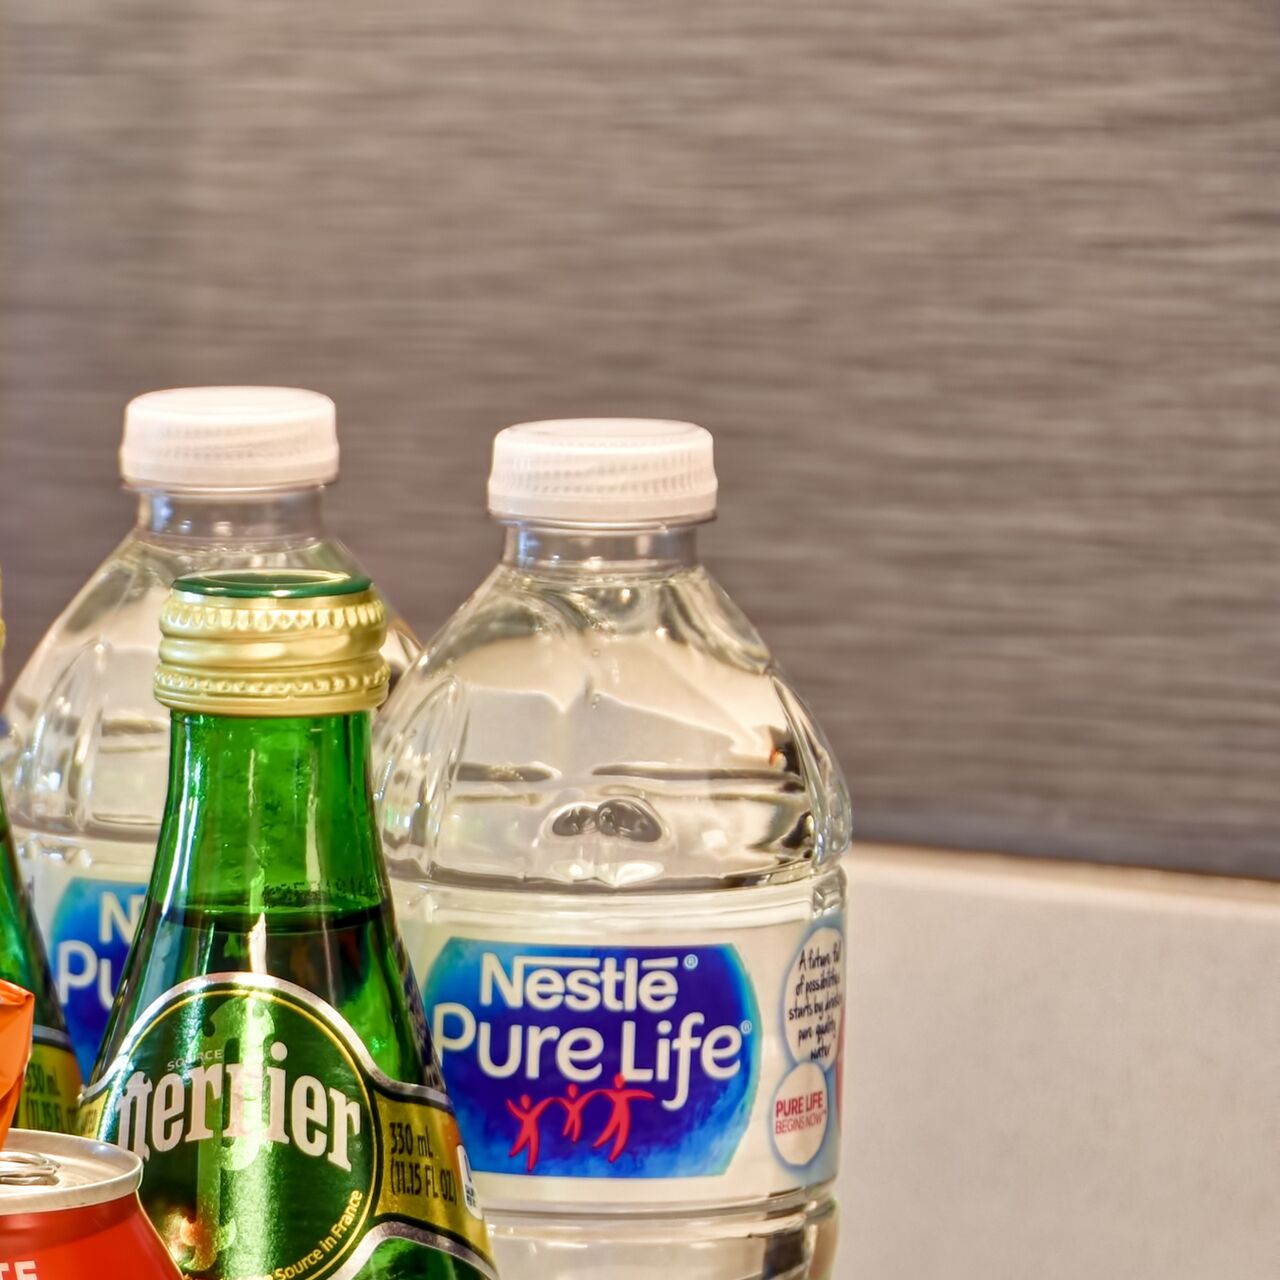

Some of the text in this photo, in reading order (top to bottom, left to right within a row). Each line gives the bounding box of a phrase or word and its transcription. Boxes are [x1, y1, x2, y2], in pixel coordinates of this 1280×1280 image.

[432, 1001, 743, 1111] Pure Life
[776, 1091, 823, 1118] PURE LIFE
[389, 1121, 414, 1156] 330
[776, 1115, 805, 1135] BEGINS
[424, 1164, 439, 1200] FL
[331, 1189, 364, 1241] France
